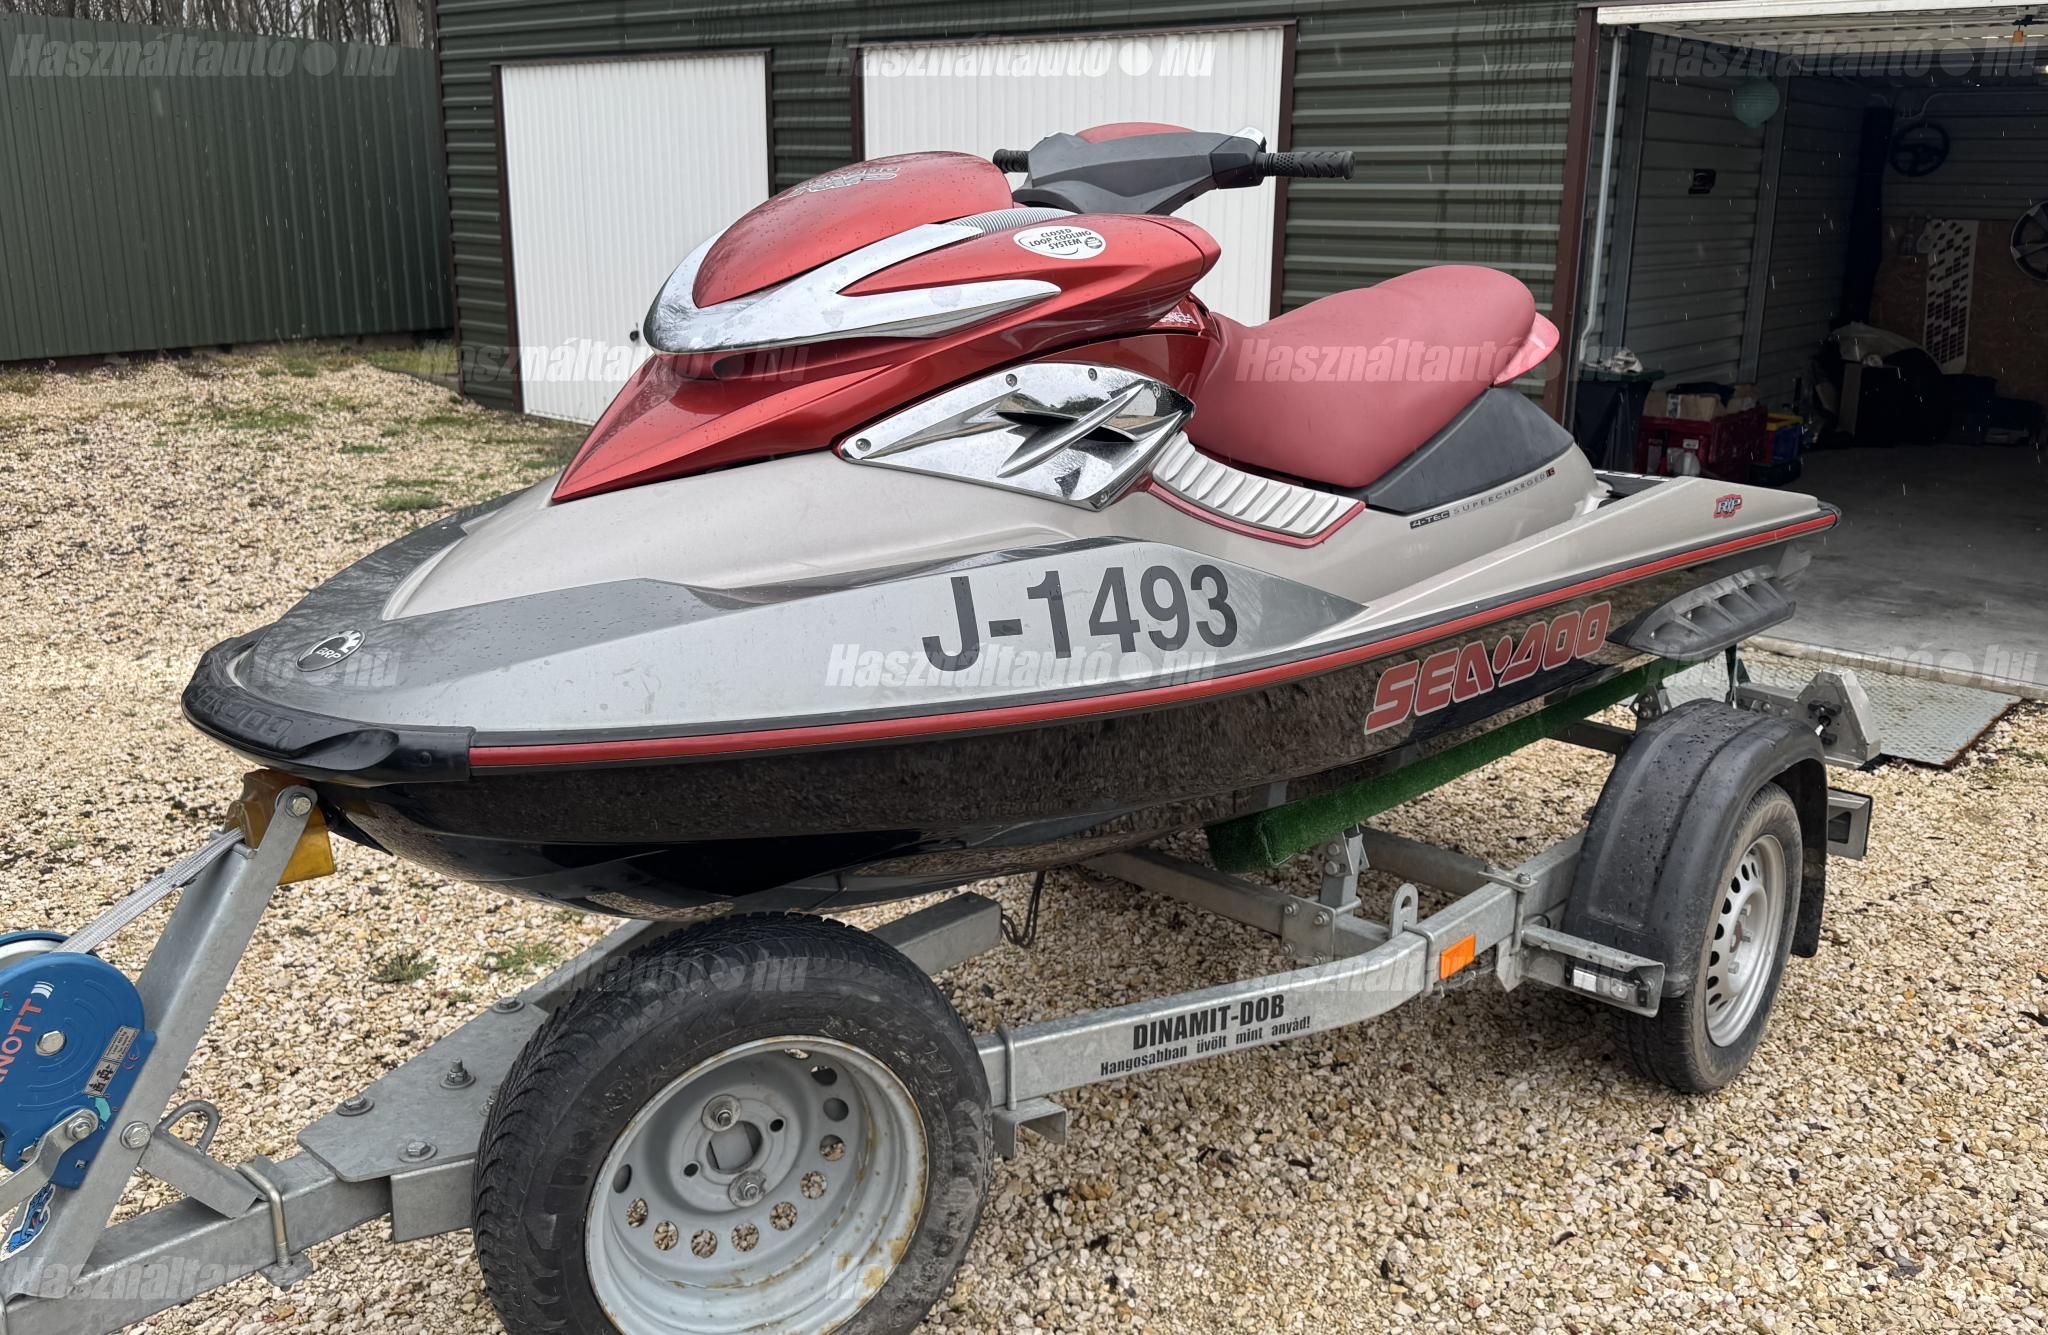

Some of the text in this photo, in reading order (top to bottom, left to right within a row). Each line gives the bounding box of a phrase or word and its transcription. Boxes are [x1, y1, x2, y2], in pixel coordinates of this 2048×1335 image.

[1029, 230, 1092, 247] LOOP COOLING
[1040, 228, 1072, 238] CLOSED
[1048, 238, 1082, 250] SYSTEM
[1453, 473, 1545, 515] SUPERCHARGED
[921, 564, 1238, 672] J-1493
[316, 647, 342, 660] BRP
[0, 998, 43, 1083] NOTT
[1133, 994, 1285, 1050] DINAMIT-DOB
[1100, 1015, 1311, 1076] Hangosabban üvölt mint anyád!
